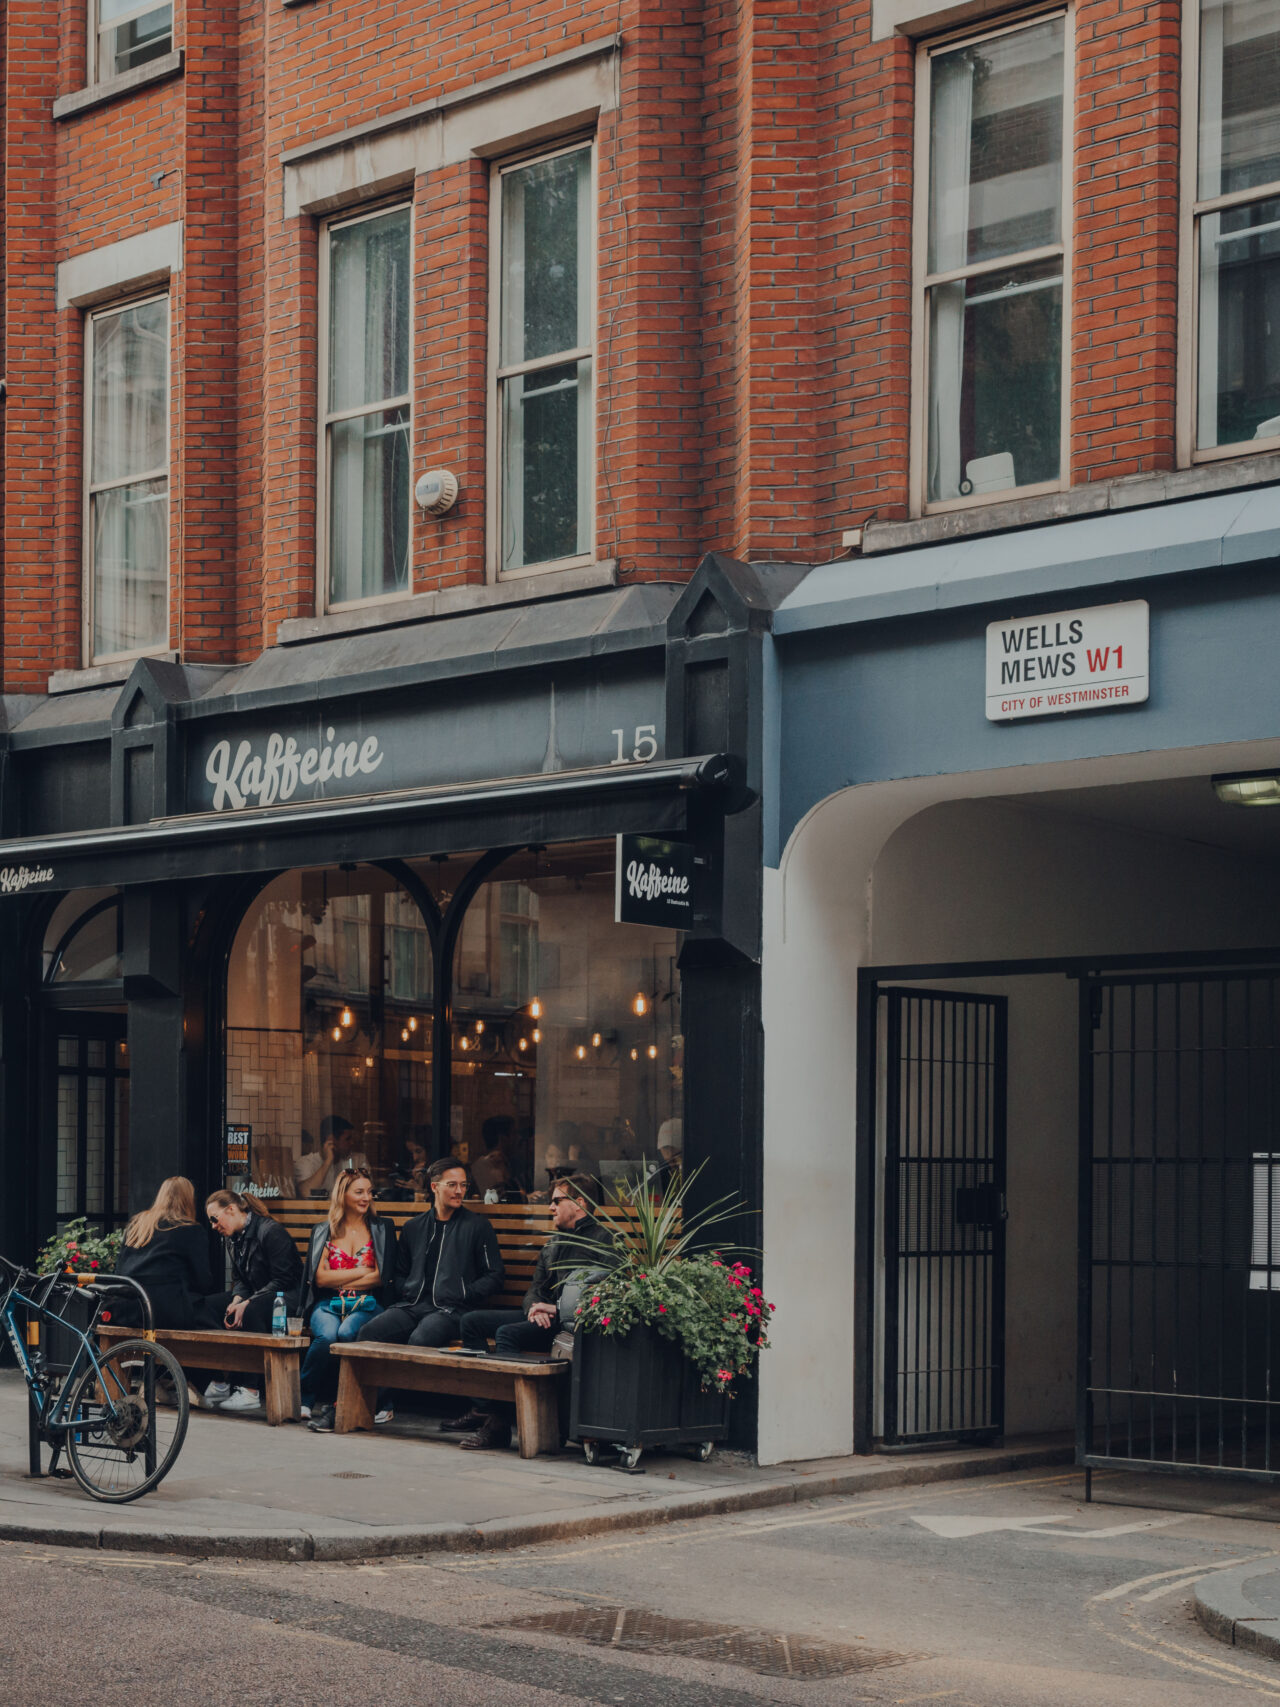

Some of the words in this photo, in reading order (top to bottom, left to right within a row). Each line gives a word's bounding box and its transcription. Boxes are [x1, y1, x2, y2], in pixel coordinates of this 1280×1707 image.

[1001, 619, 1083, 654] WELLS
[1001, 652, 1075, 685] MEWS
[1086, 645, 1123, 673] W1
[1001, 698, 1026, 712] CITY
[1029, 696, 1043, 709] OF
[1047, 685, 1129, 706] WESTMINSTER
[611, 725, 658, 765] 15
[205, 726, 384, 812] Kaffeine
[0, 864, 55, 893] Kaffeine
[626, 860, 690, 901] Kaffeine
[227, 1132, 248, 1145] BEST
